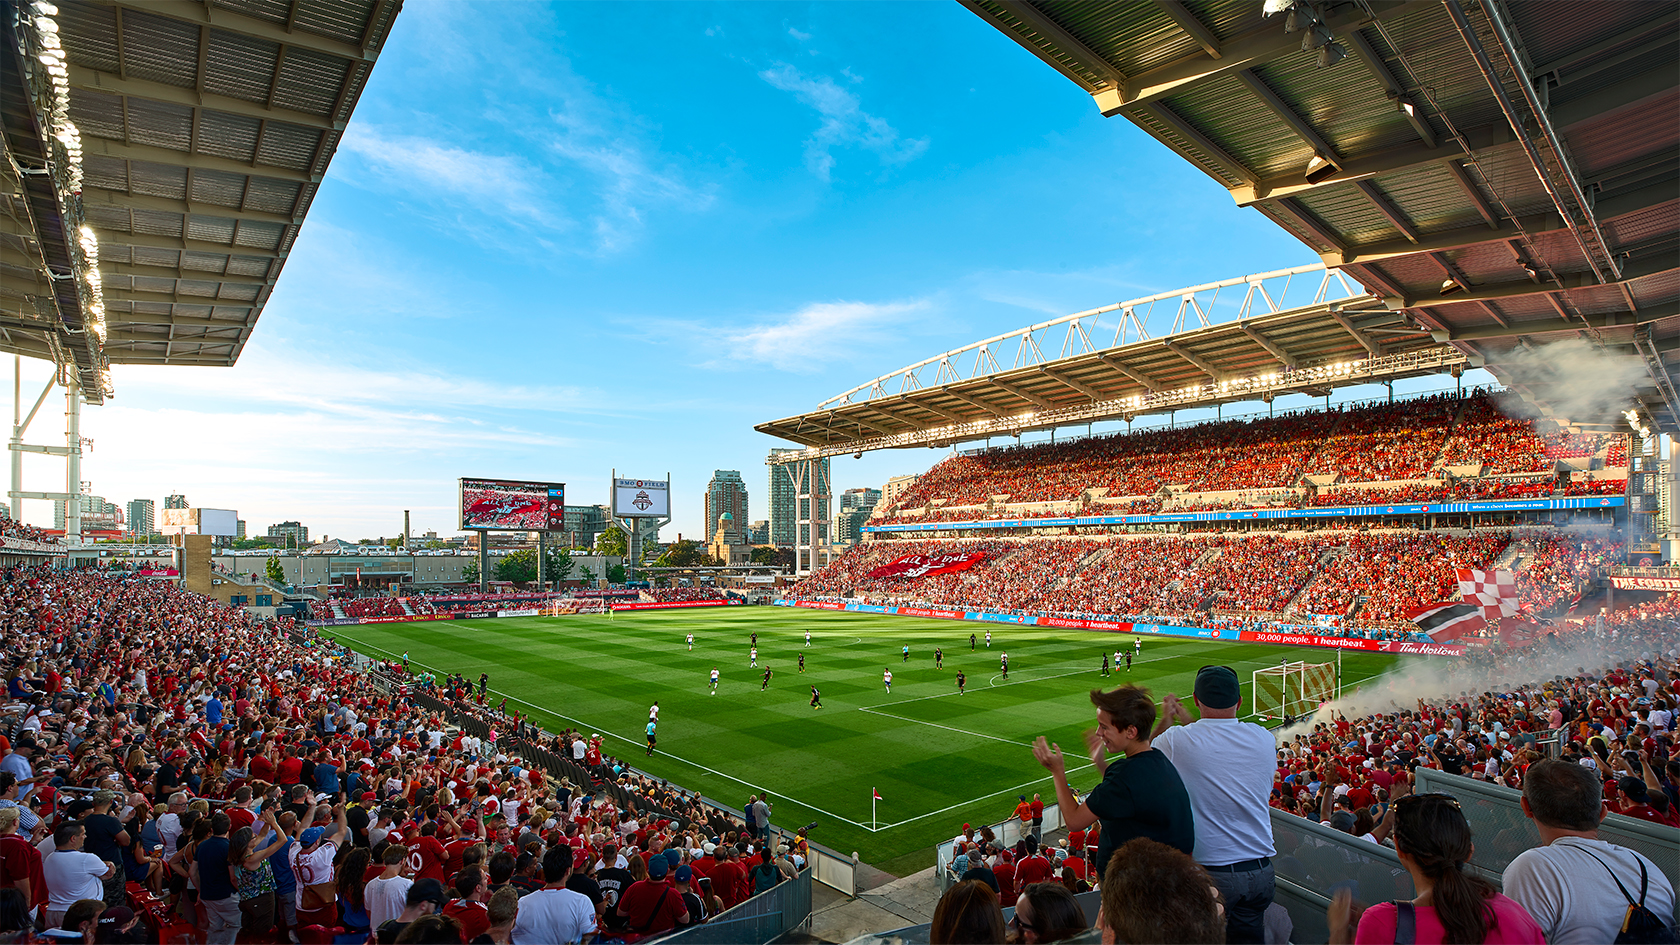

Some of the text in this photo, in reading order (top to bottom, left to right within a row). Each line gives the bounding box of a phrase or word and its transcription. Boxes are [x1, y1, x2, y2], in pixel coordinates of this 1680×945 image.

[1611, 578, 1636, 588] THE
[1256, 634, 1281, 642] 30,000
[1282, 635, 1310, 644] people.
[1320, 637, 1366, 648] heartbeat.
[1400, 642, 1460, 656] Tim Hortons
